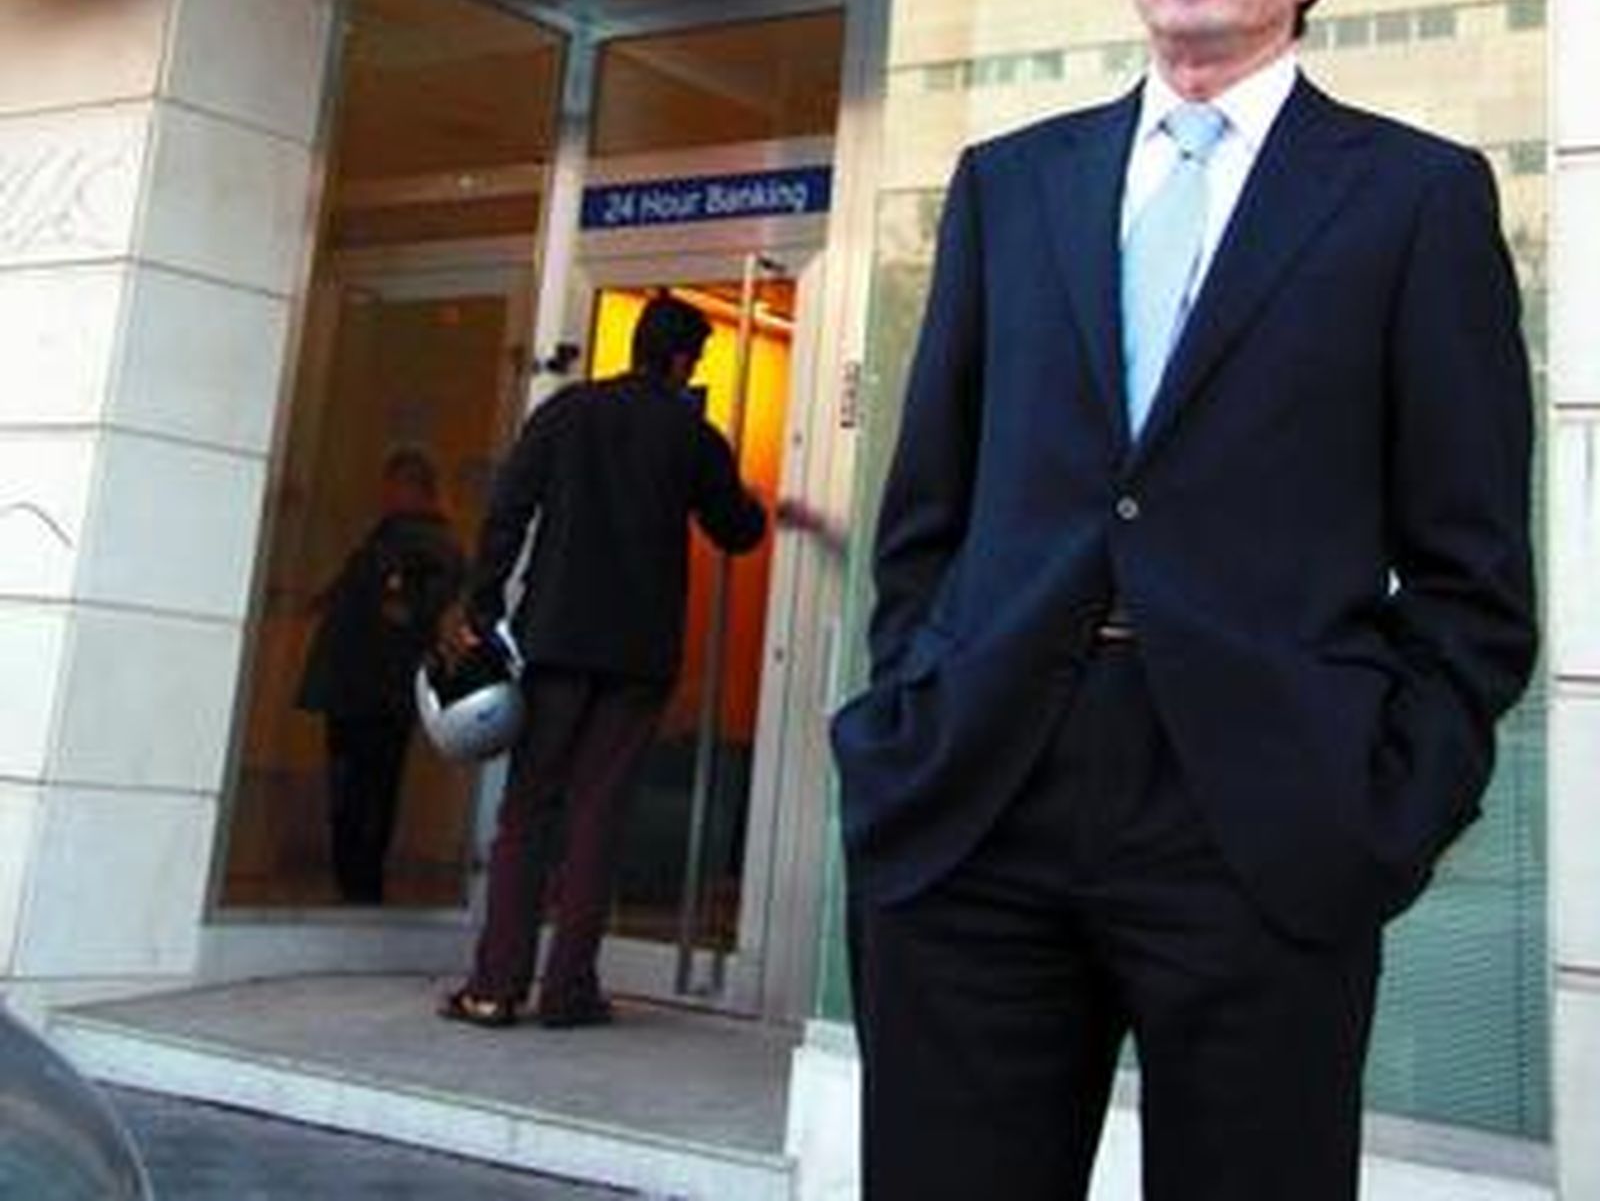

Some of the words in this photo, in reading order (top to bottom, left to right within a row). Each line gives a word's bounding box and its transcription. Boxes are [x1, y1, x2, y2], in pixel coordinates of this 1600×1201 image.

[603, 191, 634, 223] 24
[641, 189, 701, 221] Hour
[705, 179, 809, 215] Banking
